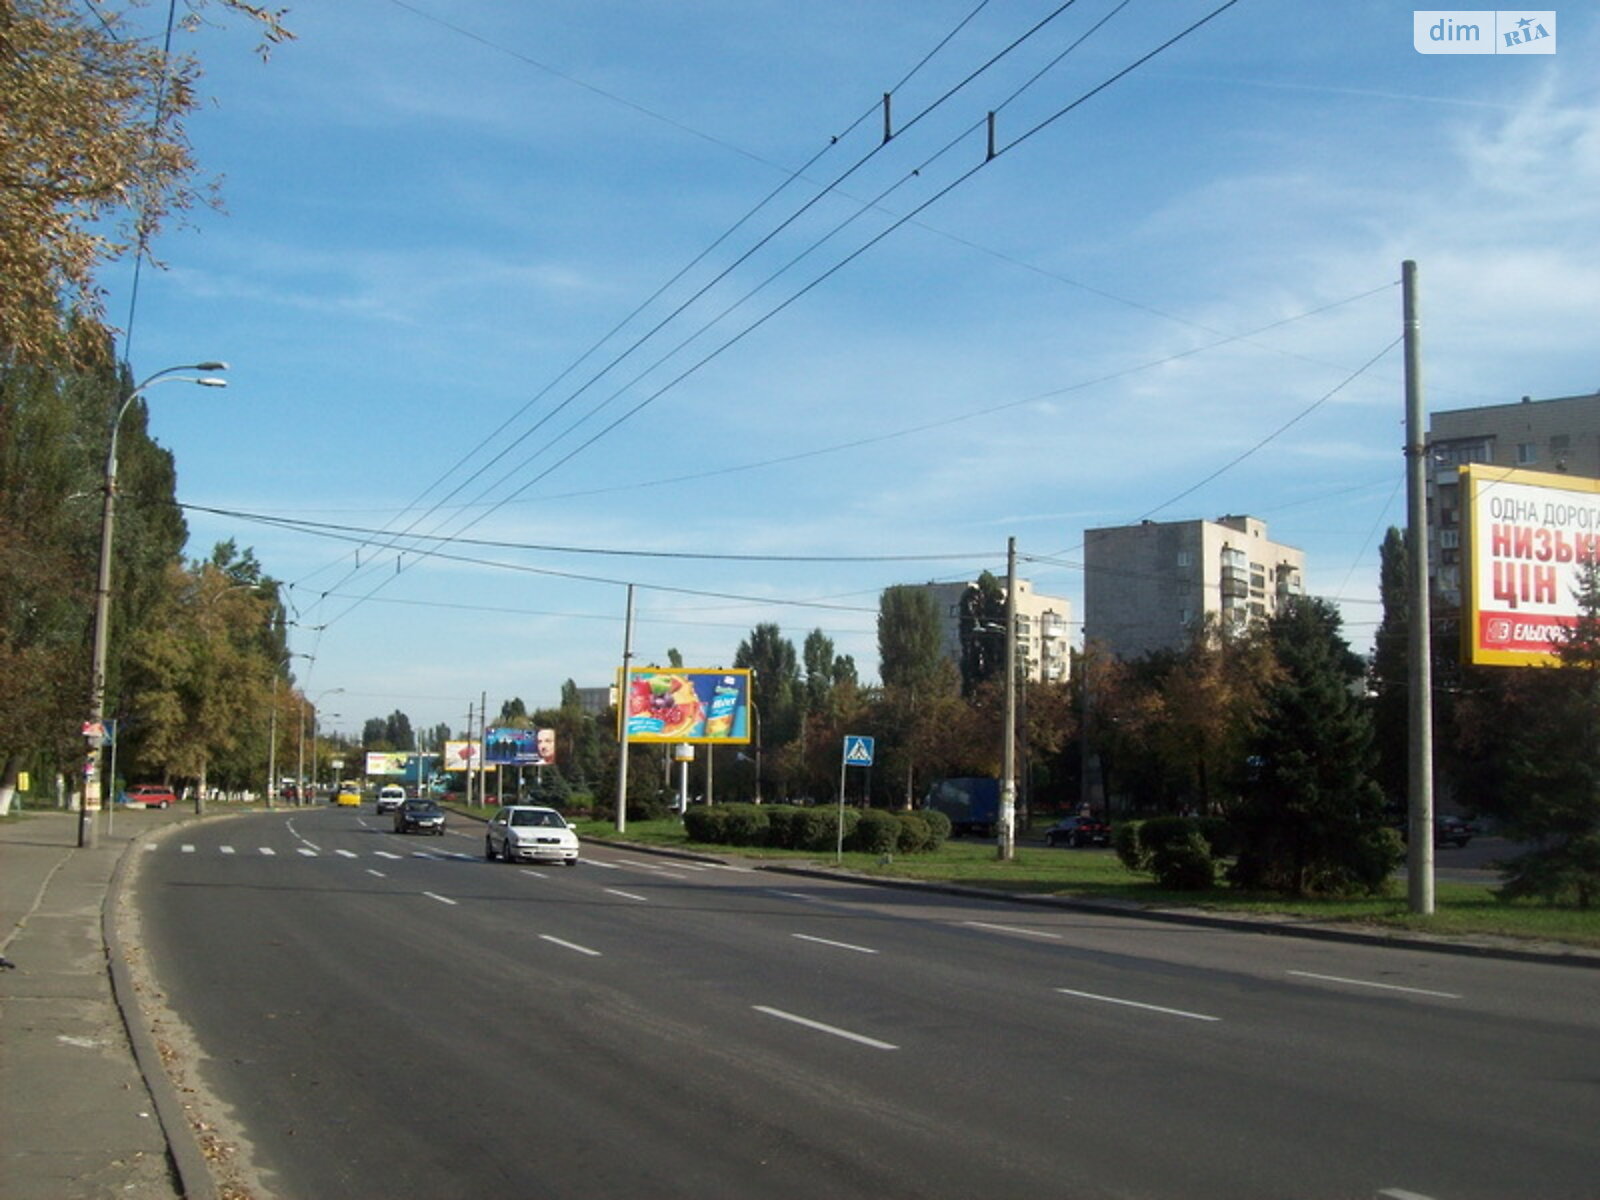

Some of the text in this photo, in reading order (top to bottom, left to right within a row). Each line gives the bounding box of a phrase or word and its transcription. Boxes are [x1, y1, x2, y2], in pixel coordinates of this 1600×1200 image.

[1490, 496, 1538, 523] ОДНА
[1492, 523, 1600, 566] НИЗЬК
[1493, 560, 1556, 609] ЦІН
